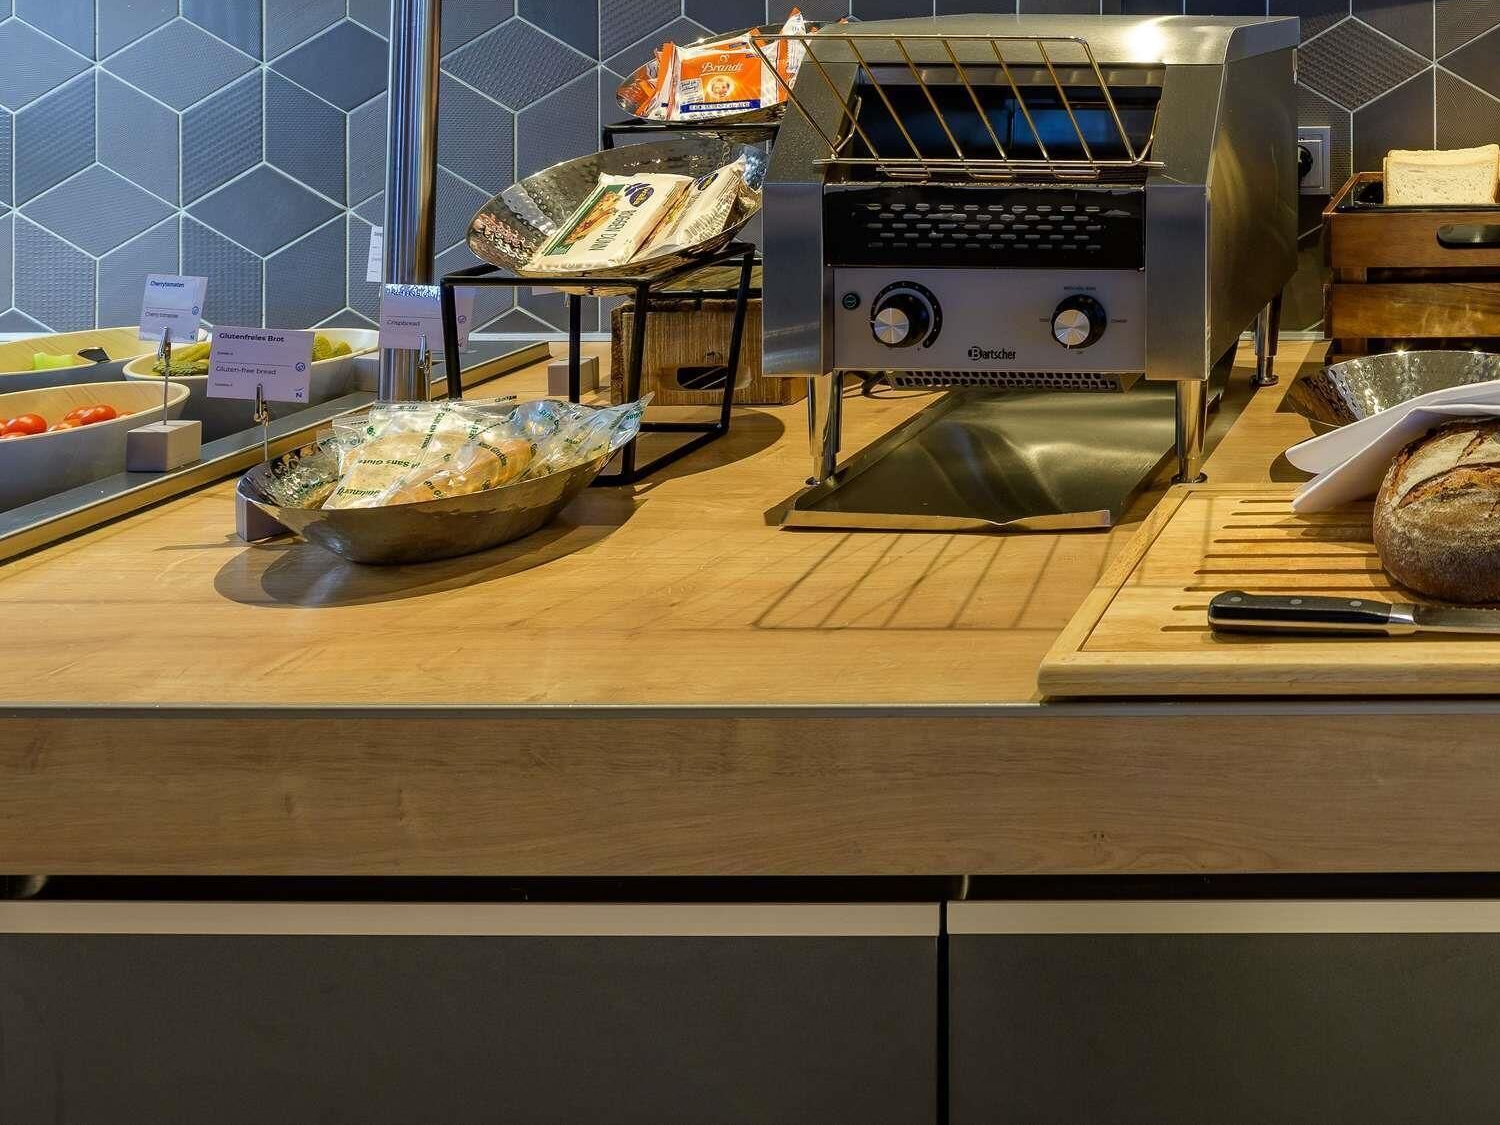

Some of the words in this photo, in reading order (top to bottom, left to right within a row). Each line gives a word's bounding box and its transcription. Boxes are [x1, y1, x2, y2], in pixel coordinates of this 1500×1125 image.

[219, 333, 266, 342] Glutenfreies
[968, 346, 1016, 361] Bartscher
[216, 366, 255, 374] Gluten-free
